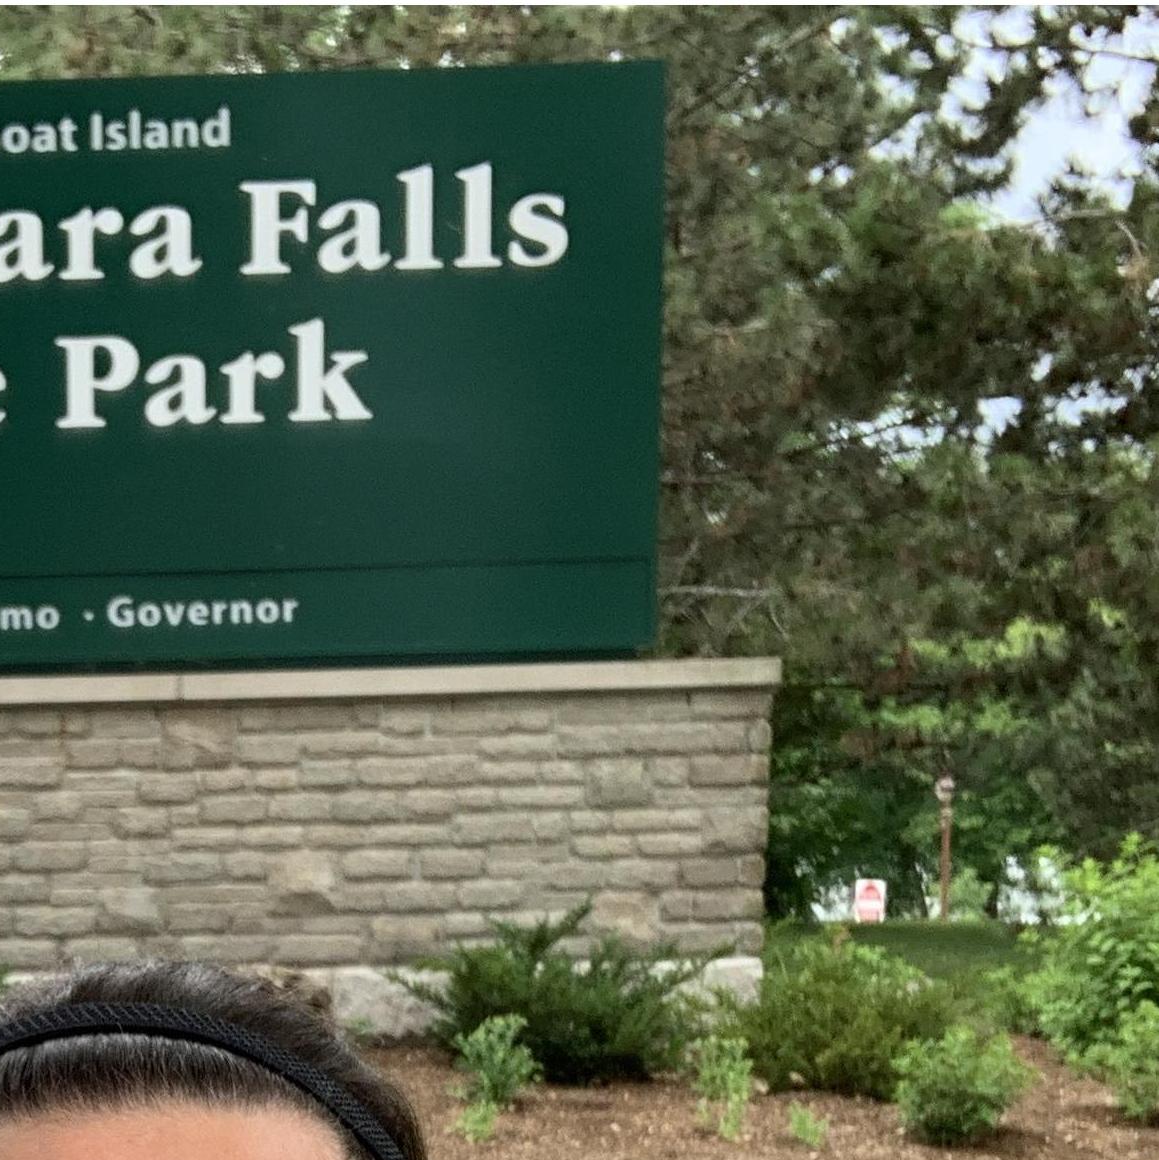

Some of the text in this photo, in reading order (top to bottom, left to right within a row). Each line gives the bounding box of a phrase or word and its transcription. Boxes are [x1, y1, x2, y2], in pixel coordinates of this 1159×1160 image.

[89, 106, 232, 151] Island
[238, 161, 570, 277] Falls
[53, 317, 375, 430] Park
[106, 595, 300, 630] Governor
